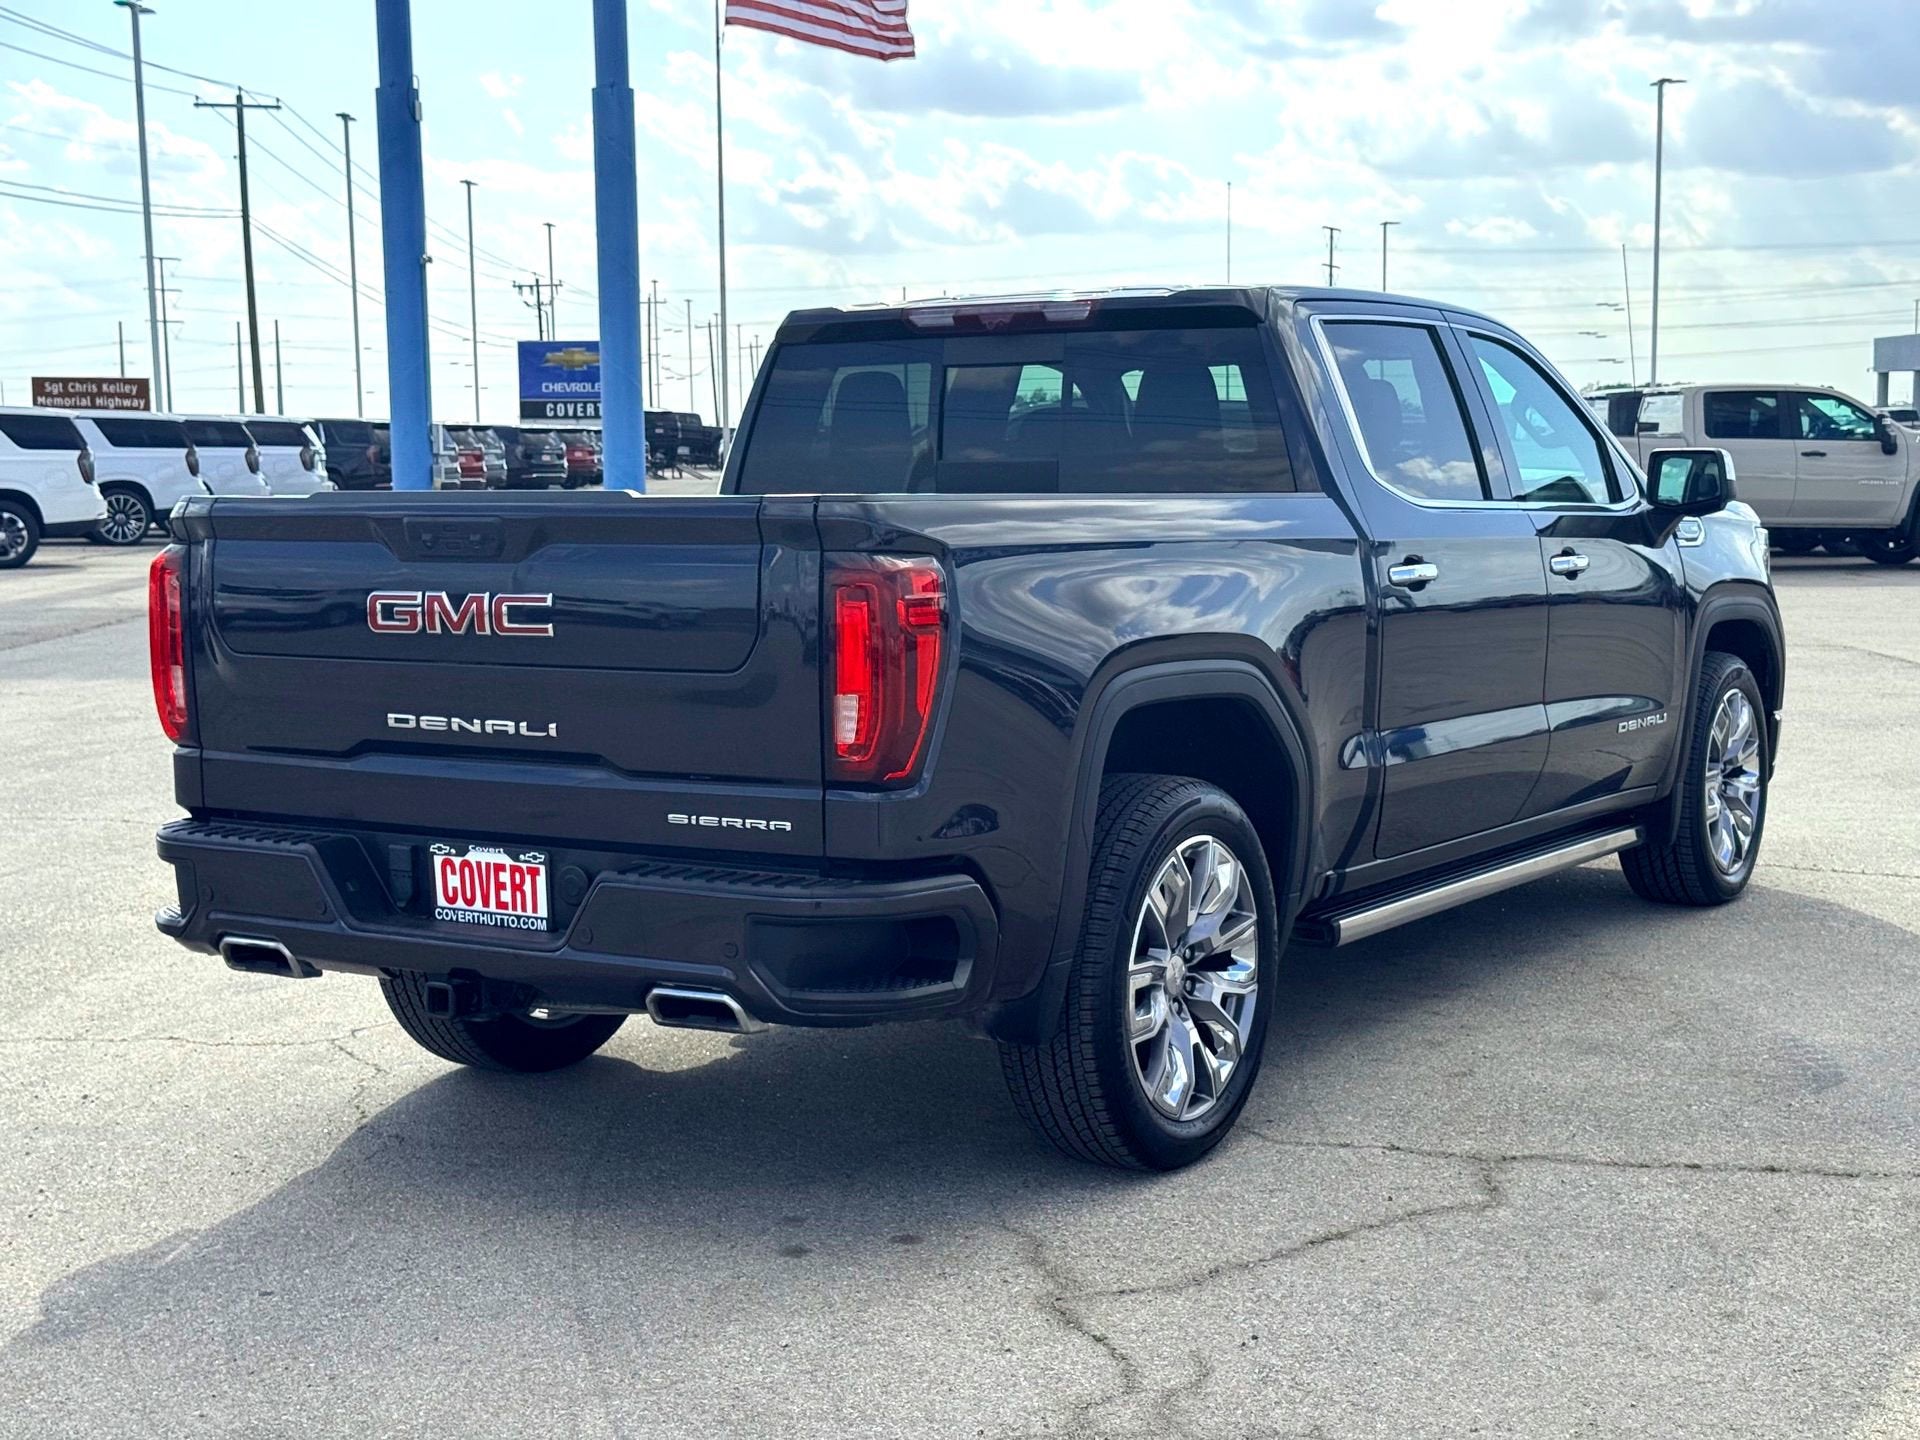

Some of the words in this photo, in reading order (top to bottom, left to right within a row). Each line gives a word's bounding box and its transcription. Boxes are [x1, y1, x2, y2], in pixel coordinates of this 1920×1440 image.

[44, 381, 63, 394] Sgt
[67, 381, 98, 393] Chris
[102, 382, 138, 396] Kelley
[541, 382, 602, 393] CHEVROLE
[37, 395, 91, 407] Memorial
[95, 396, 145, 409] Highway
[367, 590, 555, 638] GMC
[386, 713, 558, 738] DENALI
[1617, 712, 1667, 733] DENALI
[667, 813, 792, 832] SIERRA
[468, 844, 504, 854] Covert
[440, 857, 541, 915] COVERT
[434, 908, 548, 931] COVERTHUTTO.COM
